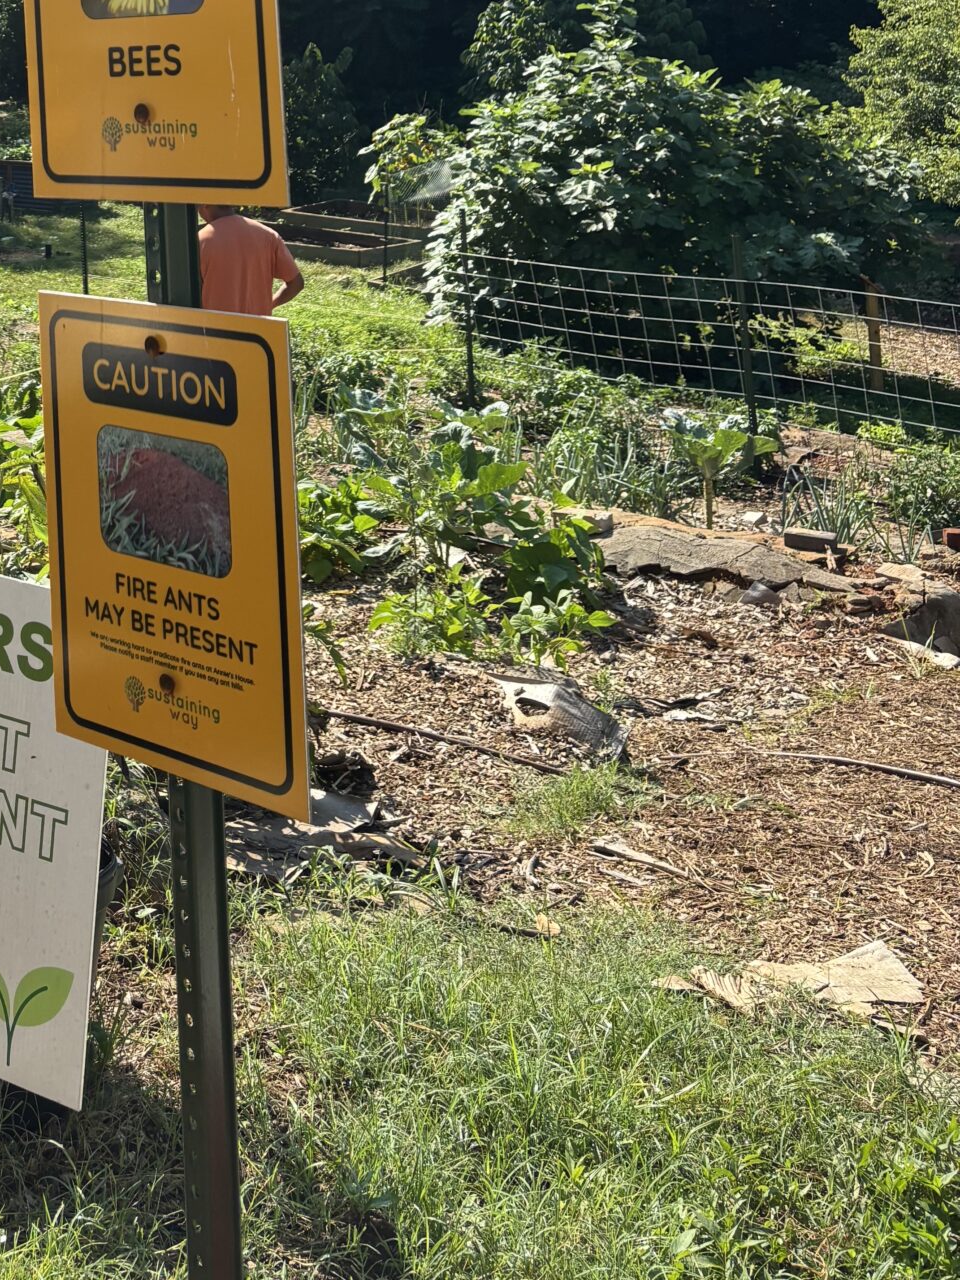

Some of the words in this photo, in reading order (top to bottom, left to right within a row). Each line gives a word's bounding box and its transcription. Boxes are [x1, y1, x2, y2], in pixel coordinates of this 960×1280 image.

[107, 43, 183, 79] BEES
[124, 119, 198, 138] sustaining
[146, 136, 176, 151] way
[92, 358, 227, 411] CAUTION
[115, 572, 158, 604] FIRE
[163, 586, 220, 621] ANTS
[84, 596, 125, 626] MAY
[131, 609, 156, 637] BE
[162, 617, 258, 665] PRESENT
[100, 641, 117, 653] Please
[118, 648, 134, 659] notify
[140, 655, 154, 664] staff
[154, 659, 178, 671] member
[184, 668, 196, 676] you
[196, 672, 207, 680] see
[207, 675, 219, 685] any
[220, 679, 230, 687] ant
[109, 637, 131, 649] working
[132, 642, 145, 652] hard
[153, 650, 180, 663] eradicate
[181, 657, 191, 666] fire
[192, 662, 205, 670] ants
[206, 665, 212, 673] at
[147, 688, 221, 724] sustaining
[169, 708, 199, 730] way
